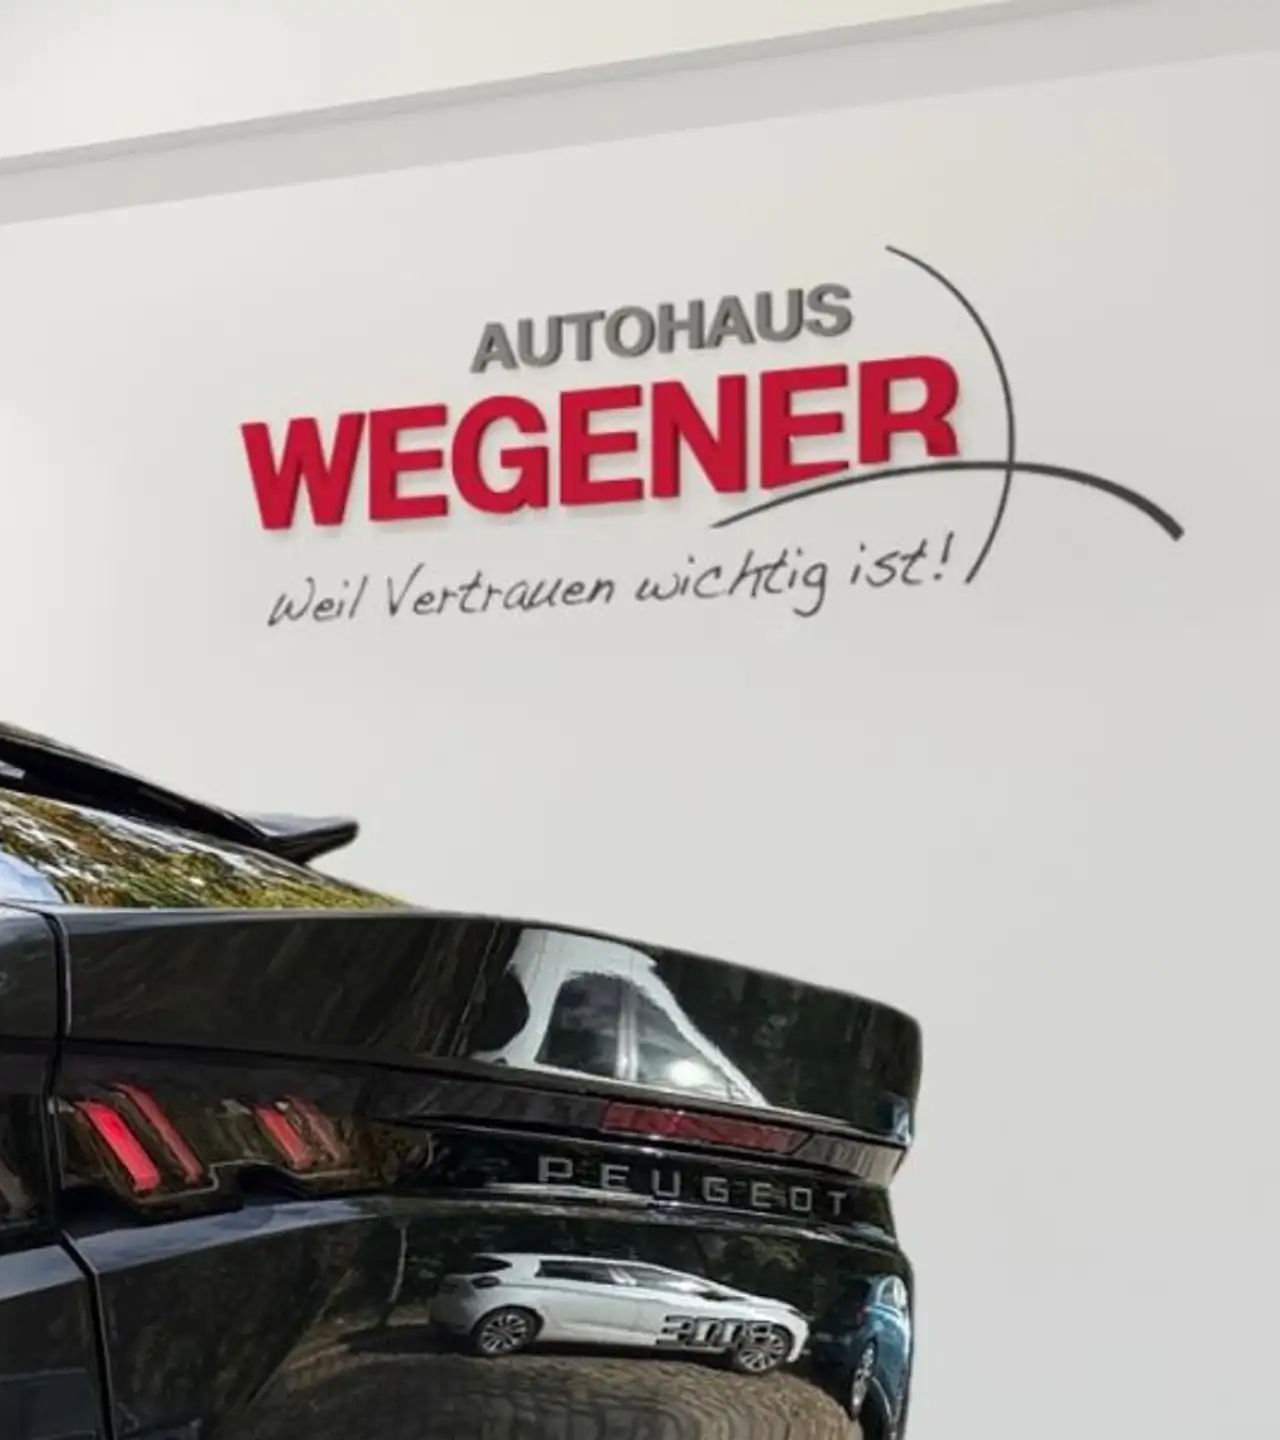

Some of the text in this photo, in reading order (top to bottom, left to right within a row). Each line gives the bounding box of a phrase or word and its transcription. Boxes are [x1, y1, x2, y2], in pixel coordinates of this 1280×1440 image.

[471, 283, 853, 373] AUTOHAUS
[240, 355, 960, 531] WEGENER
[268, 531, 955, 627] Weil Vertrauen wichtig ist!
[539, 1156, 849, 1214] PEUGEOT
